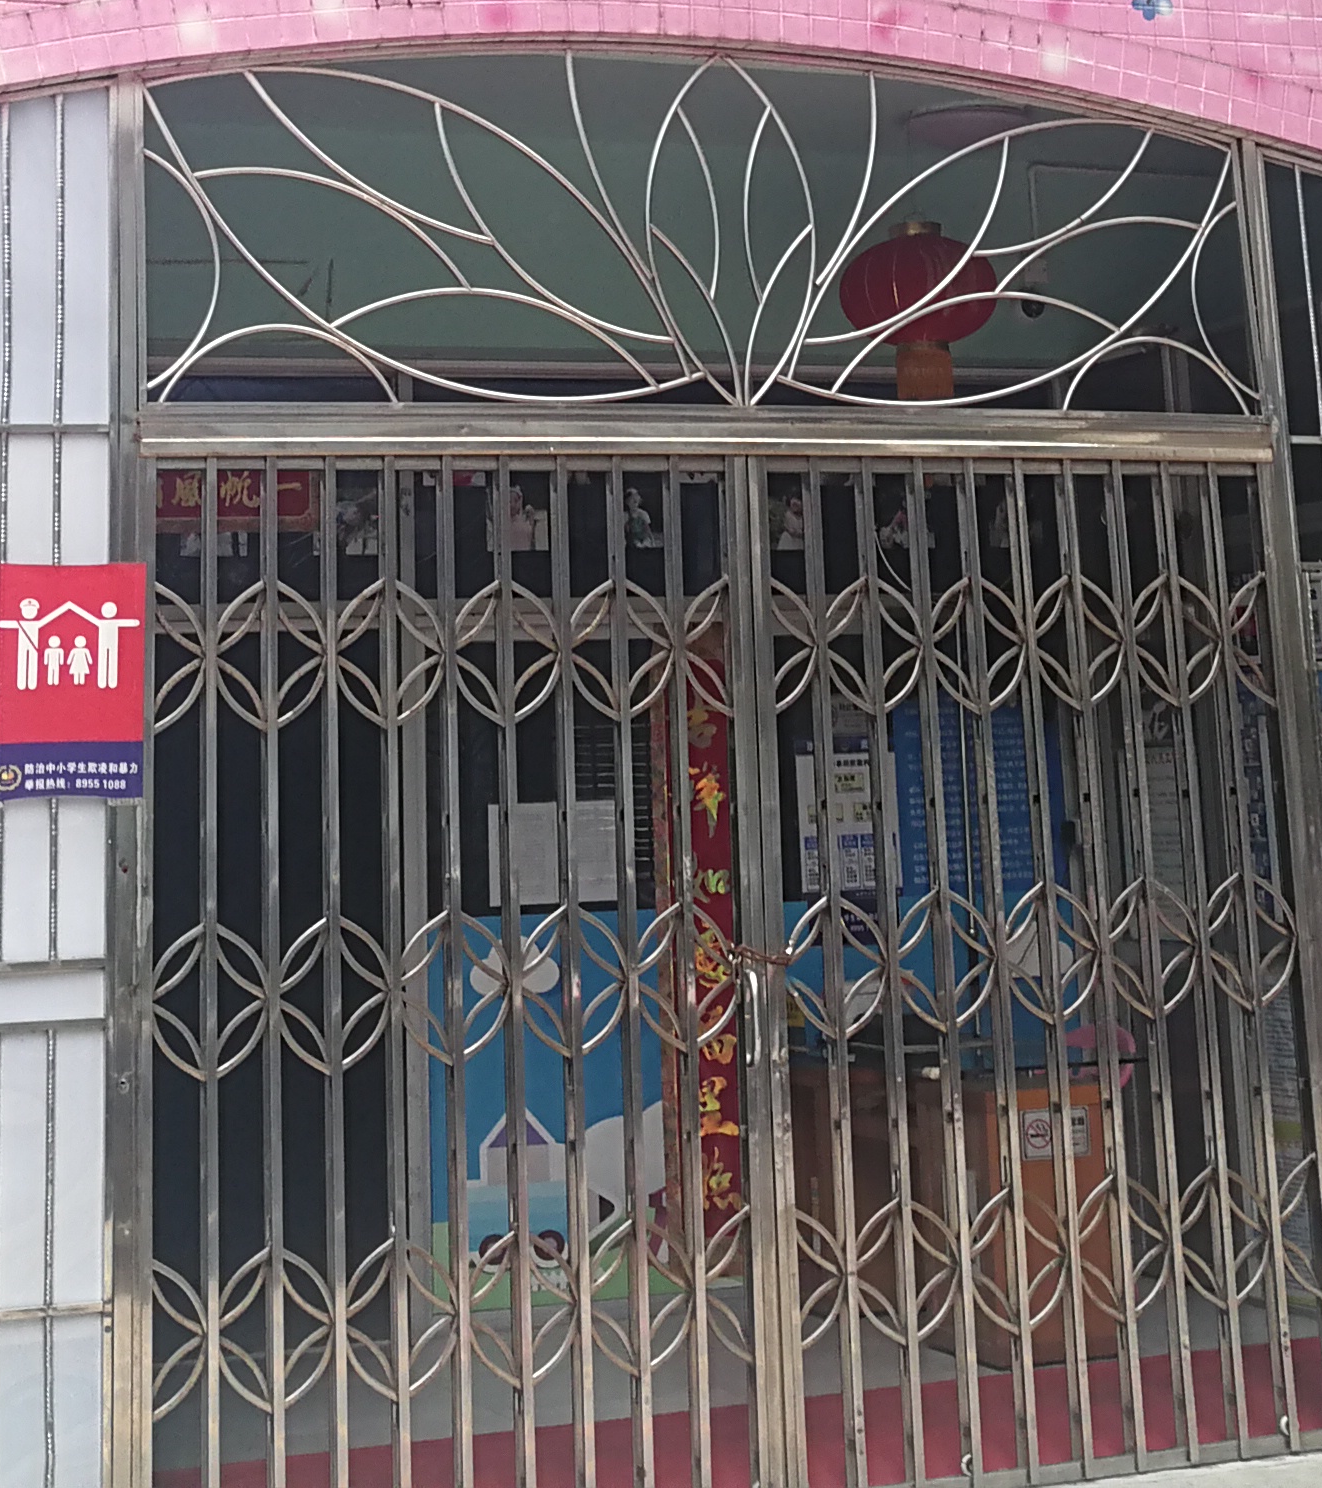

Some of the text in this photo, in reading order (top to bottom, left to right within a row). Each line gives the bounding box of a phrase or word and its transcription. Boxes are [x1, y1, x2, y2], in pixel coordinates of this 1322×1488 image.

[24, 761, 138, 775] 防治中小学生欺凌和暴力
